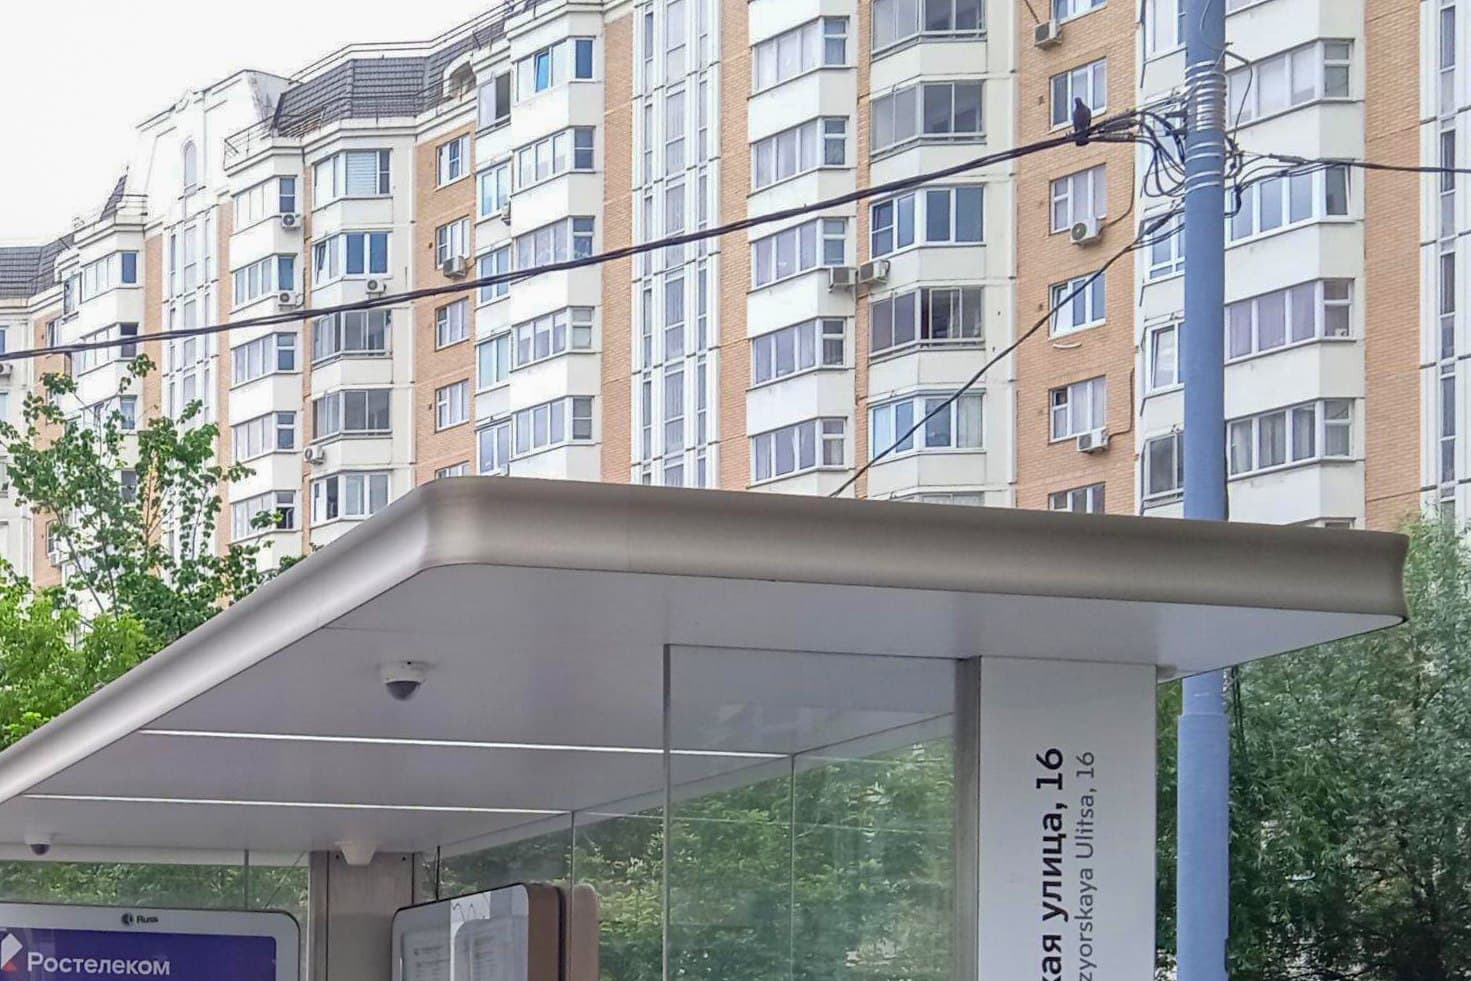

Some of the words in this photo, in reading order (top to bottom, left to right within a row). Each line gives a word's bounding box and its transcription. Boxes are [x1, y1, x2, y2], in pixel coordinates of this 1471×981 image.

[1036, 747, 1063, 790] 16
[1075, 751, 1095, 780] 16
[1074, 788, 1098, 859] Ulitsa,
[1037, 799, 1069, 923] улица,
[28, 952, 170, 976] Ростелеком
